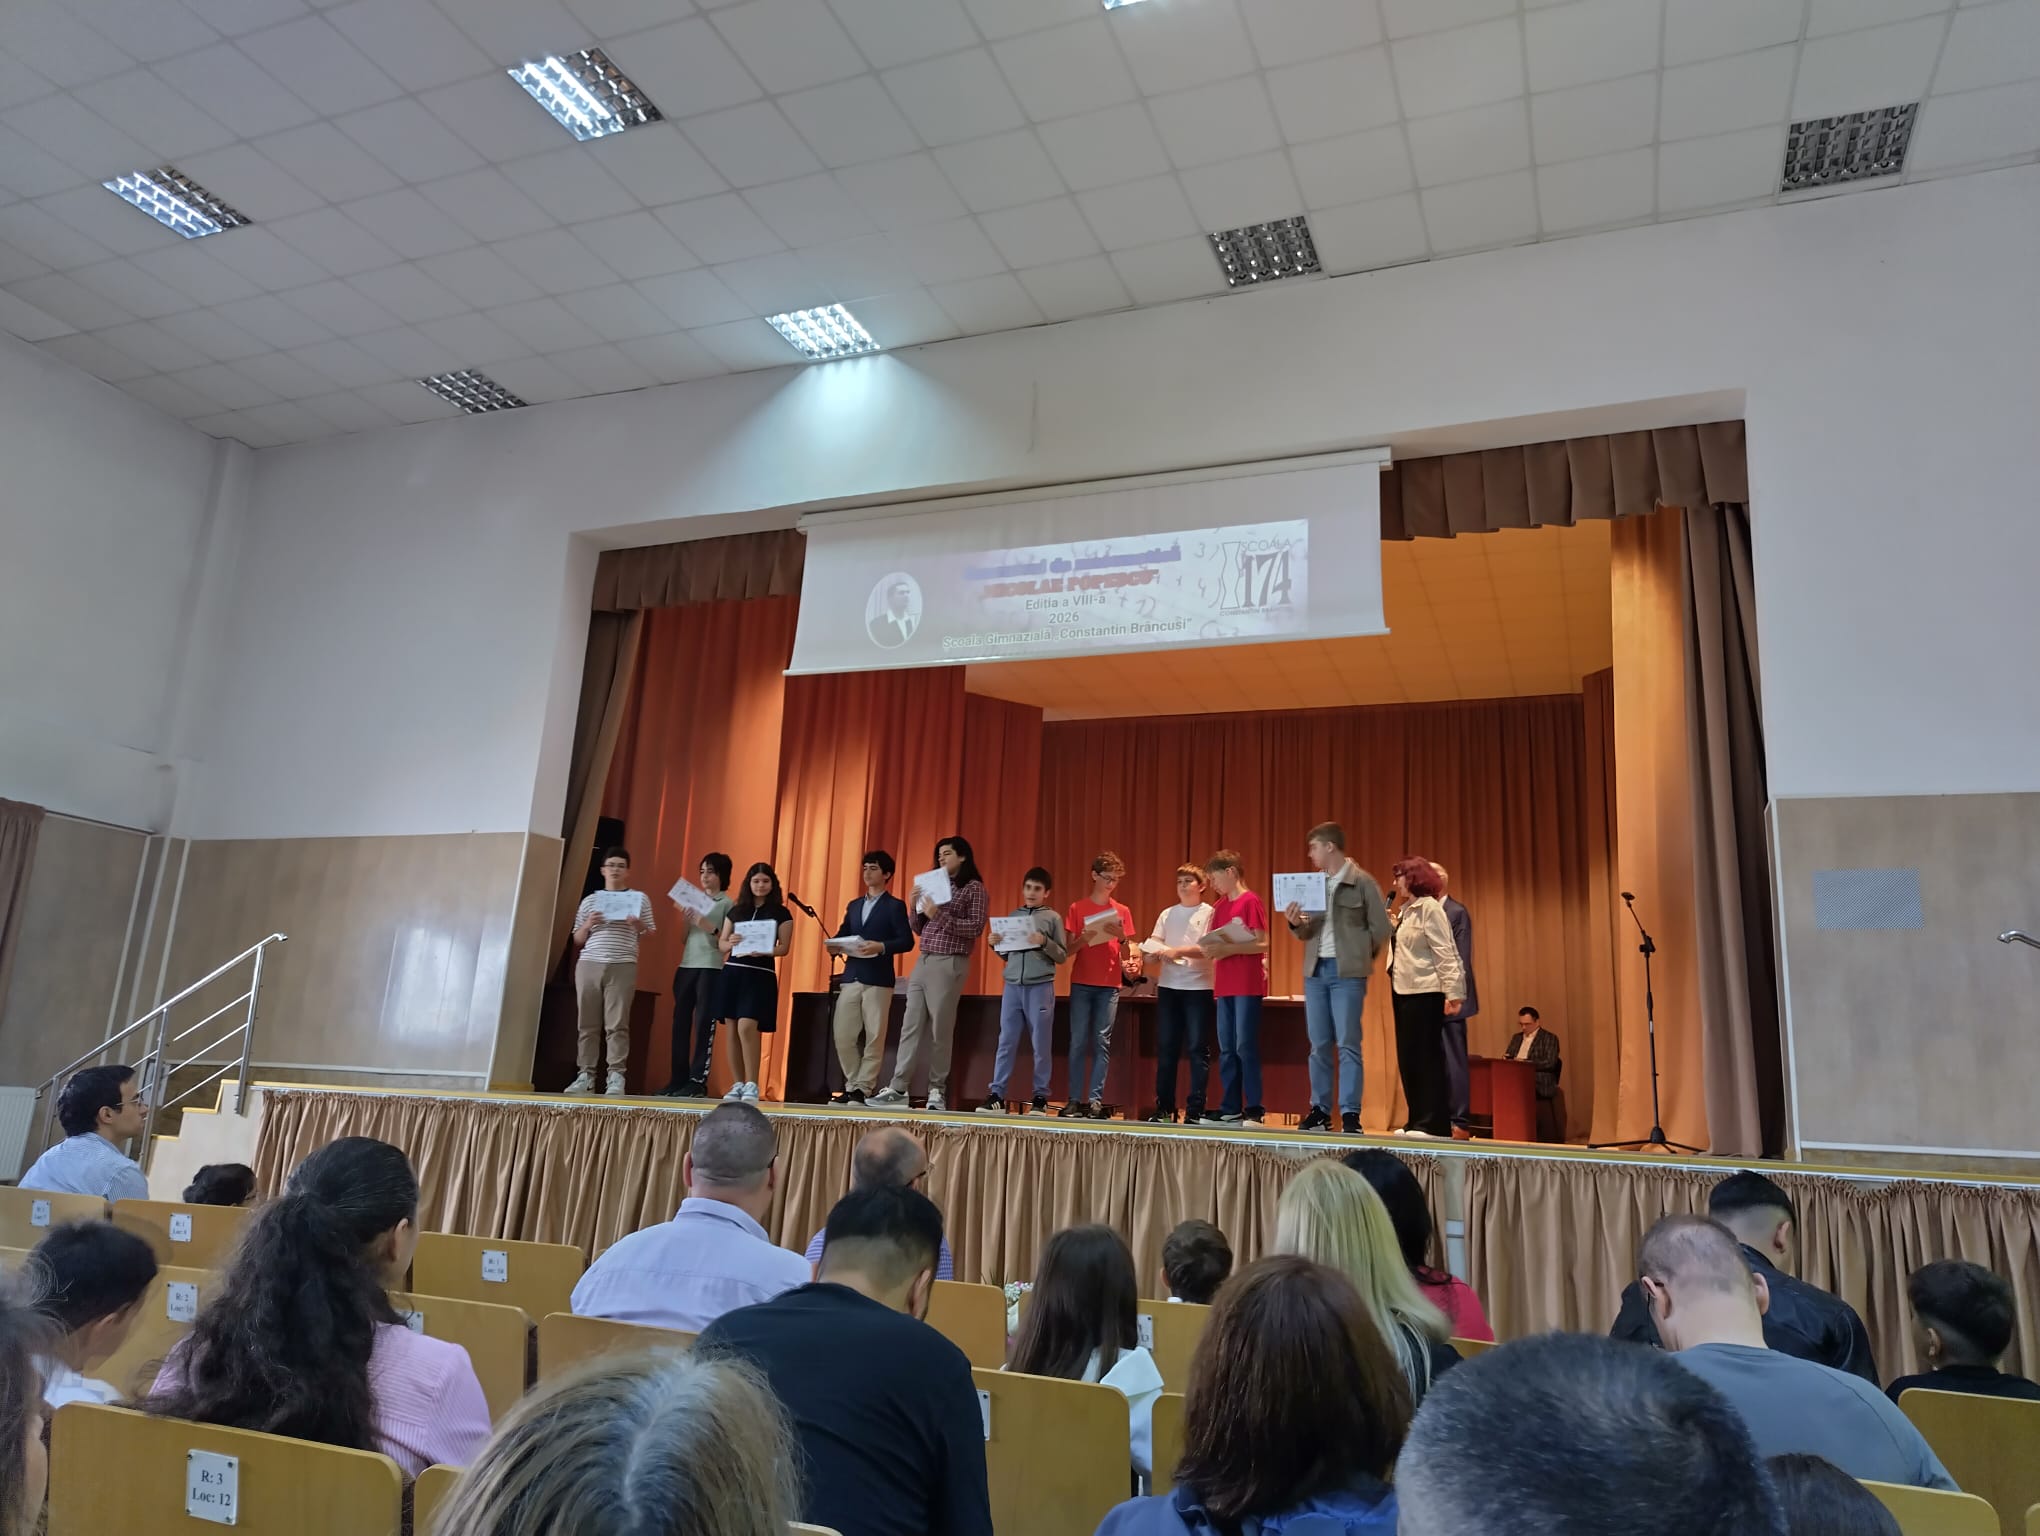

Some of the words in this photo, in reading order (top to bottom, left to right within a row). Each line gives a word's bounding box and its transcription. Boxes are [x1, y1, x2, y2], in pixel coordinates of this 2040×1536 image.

[1241, 549, 1292, 608] 174
[1073, 594, 1106, 606] VIII-a
[1049, 611, 1080, 624] 2026
[201, 1469, 214, 1483] R:
[216, 1472, 223, 1485] 3
[192, 1487, 215, 1504] Loc:
[219, 1493, 231, 1506] 12
